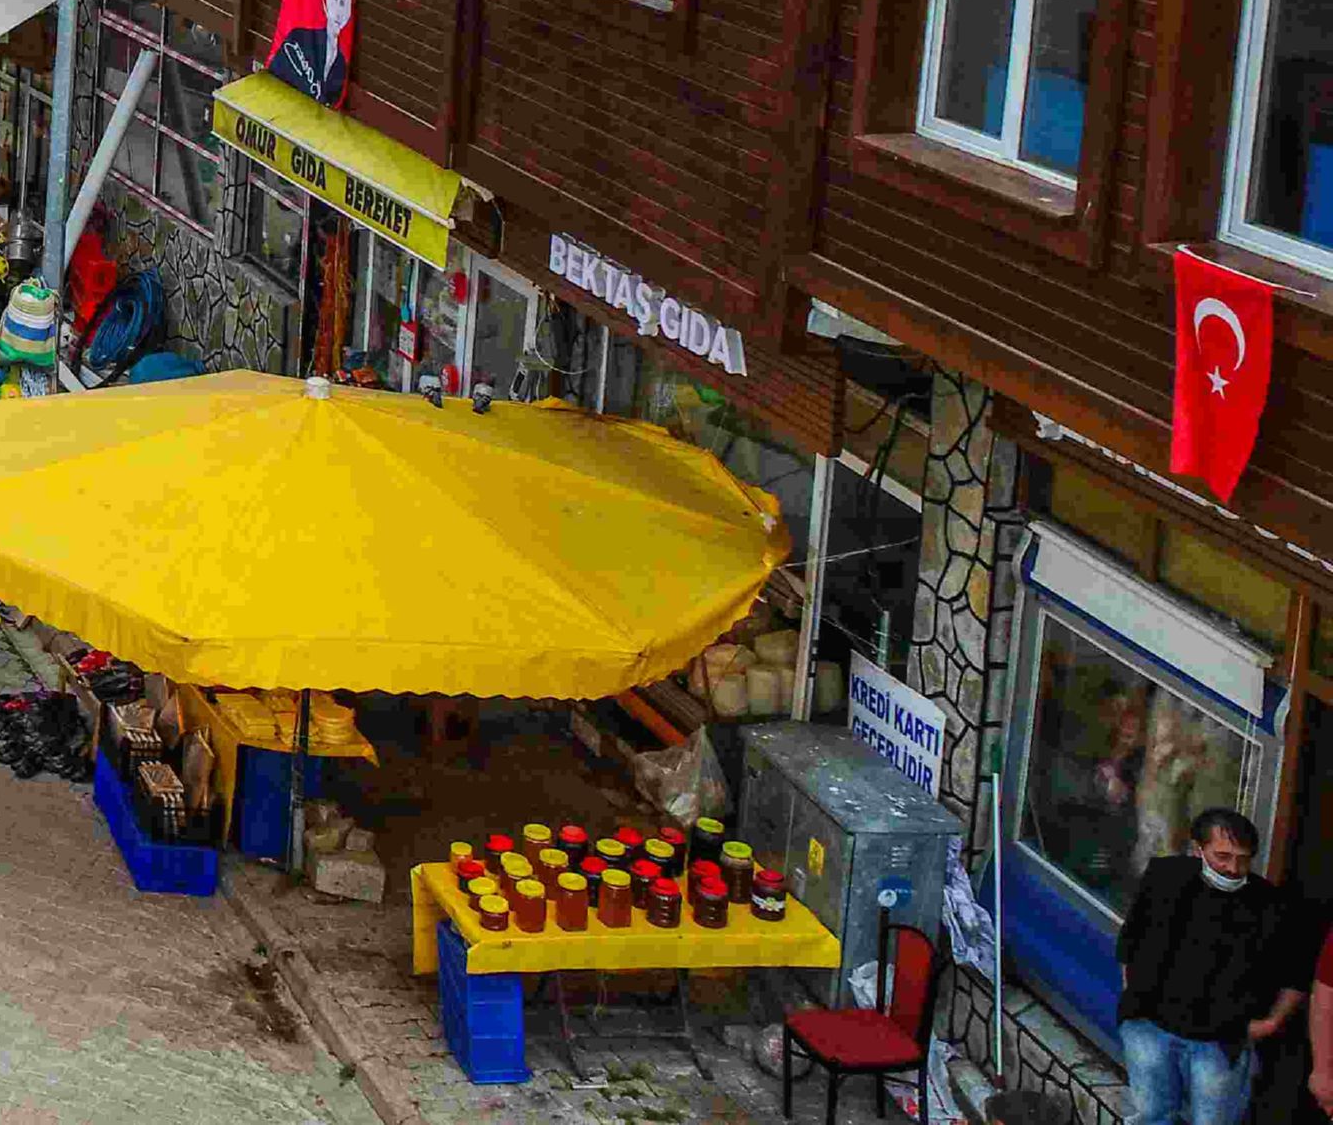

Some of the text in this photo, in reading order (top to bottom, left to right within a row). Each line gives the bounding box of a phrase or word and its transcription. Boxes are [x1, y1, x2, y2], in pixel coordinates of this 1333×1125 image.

[291, 147, 327, 191] GIDA
[345, 175, 412, 238] BEREKET
[549, 233, 747, 376] BEKTAŞ GIDA
[851, 674, 939, 756] KREDİ KARTI
